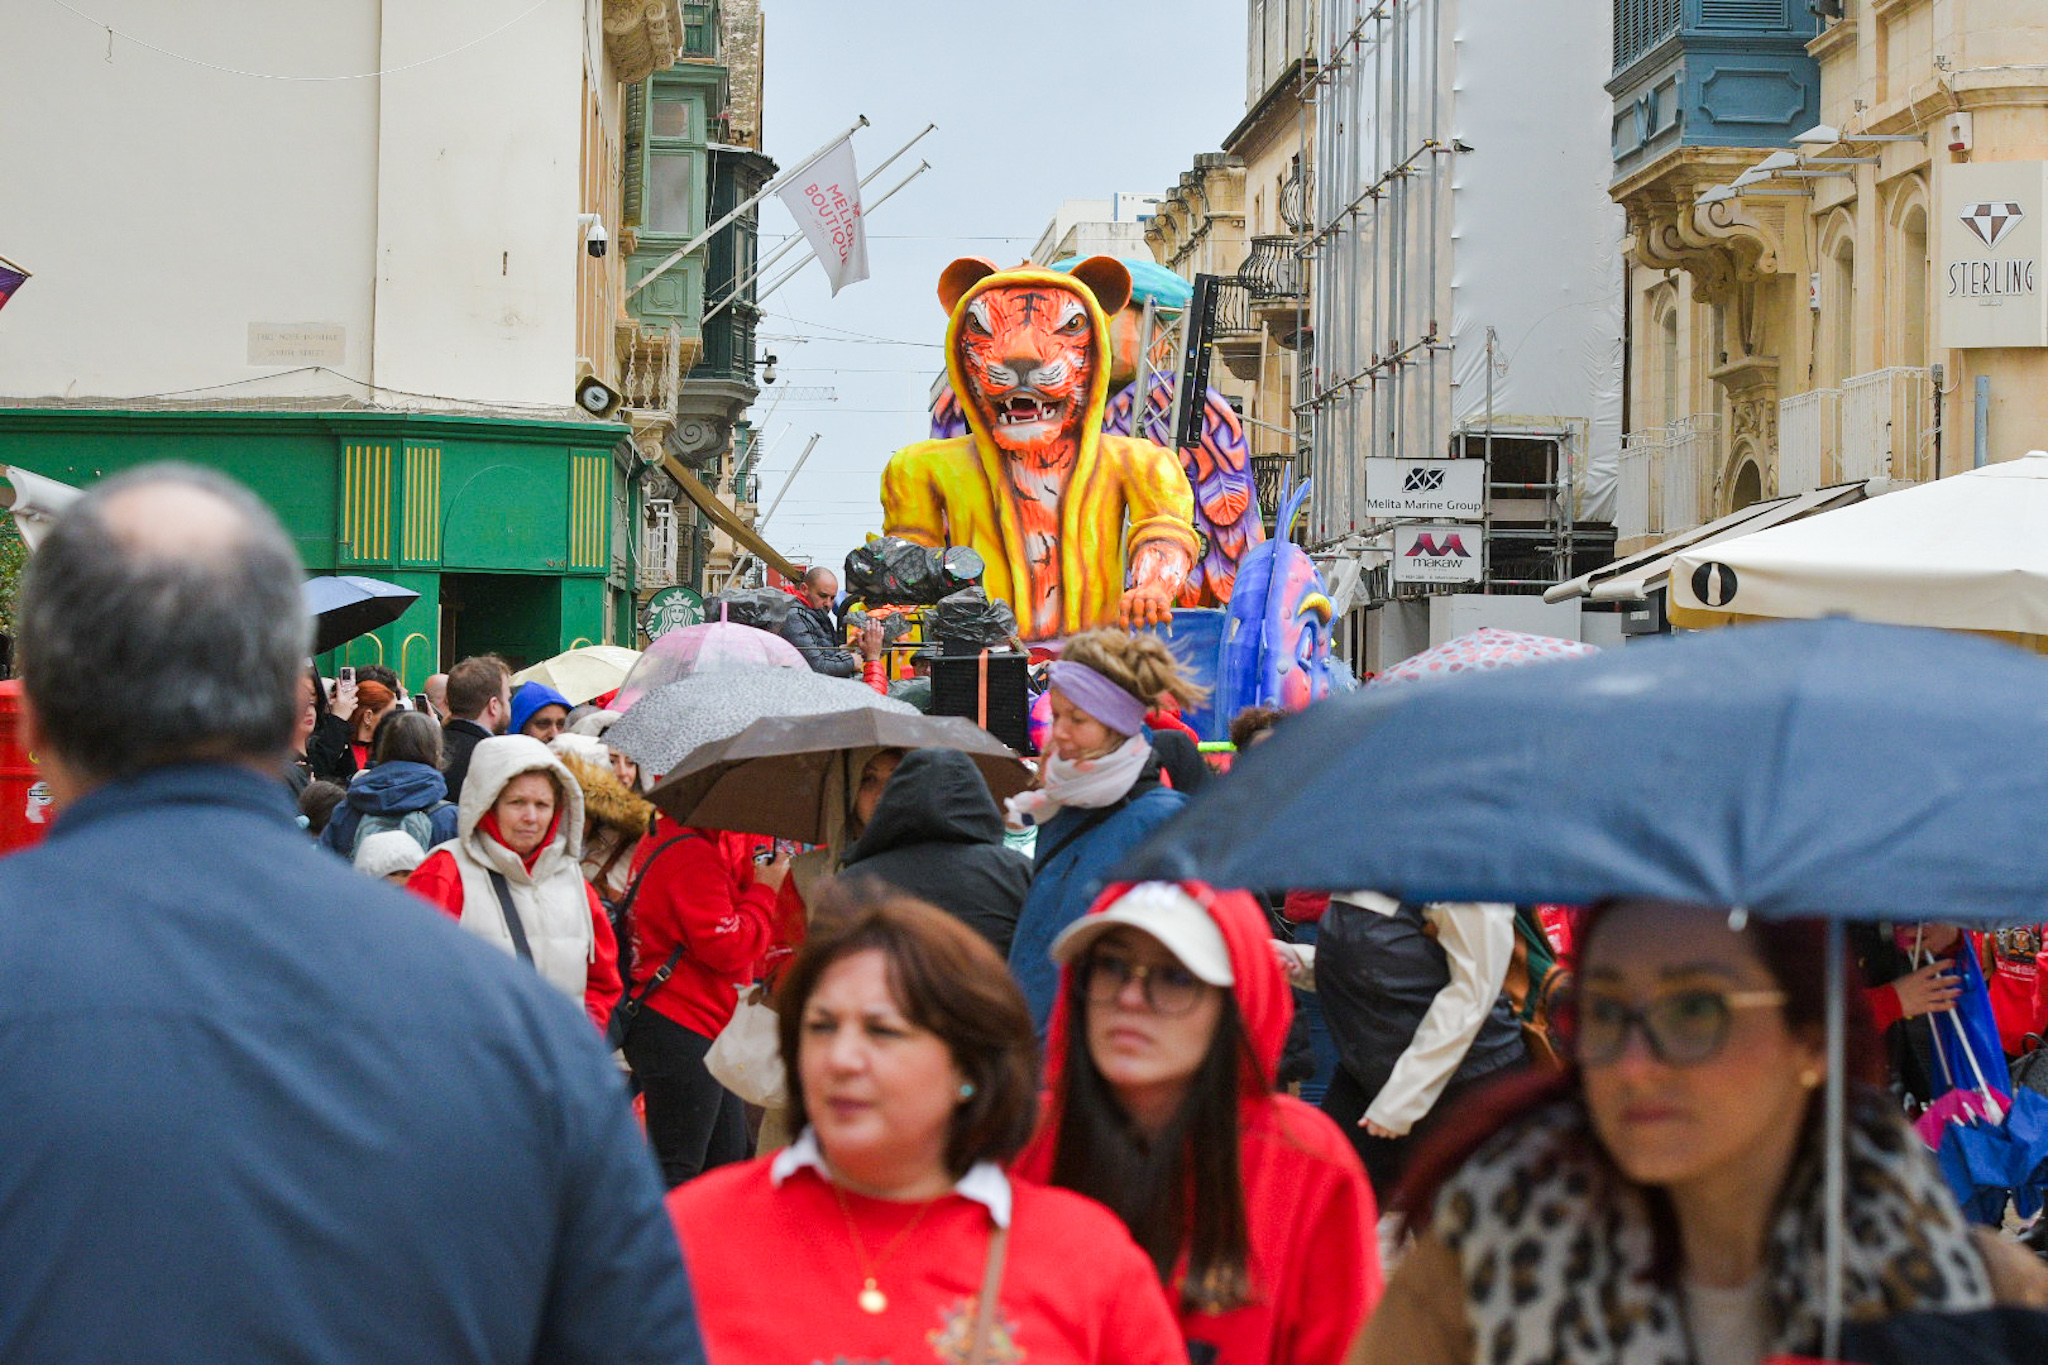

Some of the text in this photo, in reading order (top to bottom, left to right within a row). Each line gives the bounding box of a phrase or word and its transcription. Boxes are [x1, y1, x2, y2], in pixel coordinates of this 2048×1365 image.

[1949, 260, 2034, 296] STERLING
[1367, 499, 1481, 513] Melita Marine Group
[1412, 558, 1463, 568] makaw
